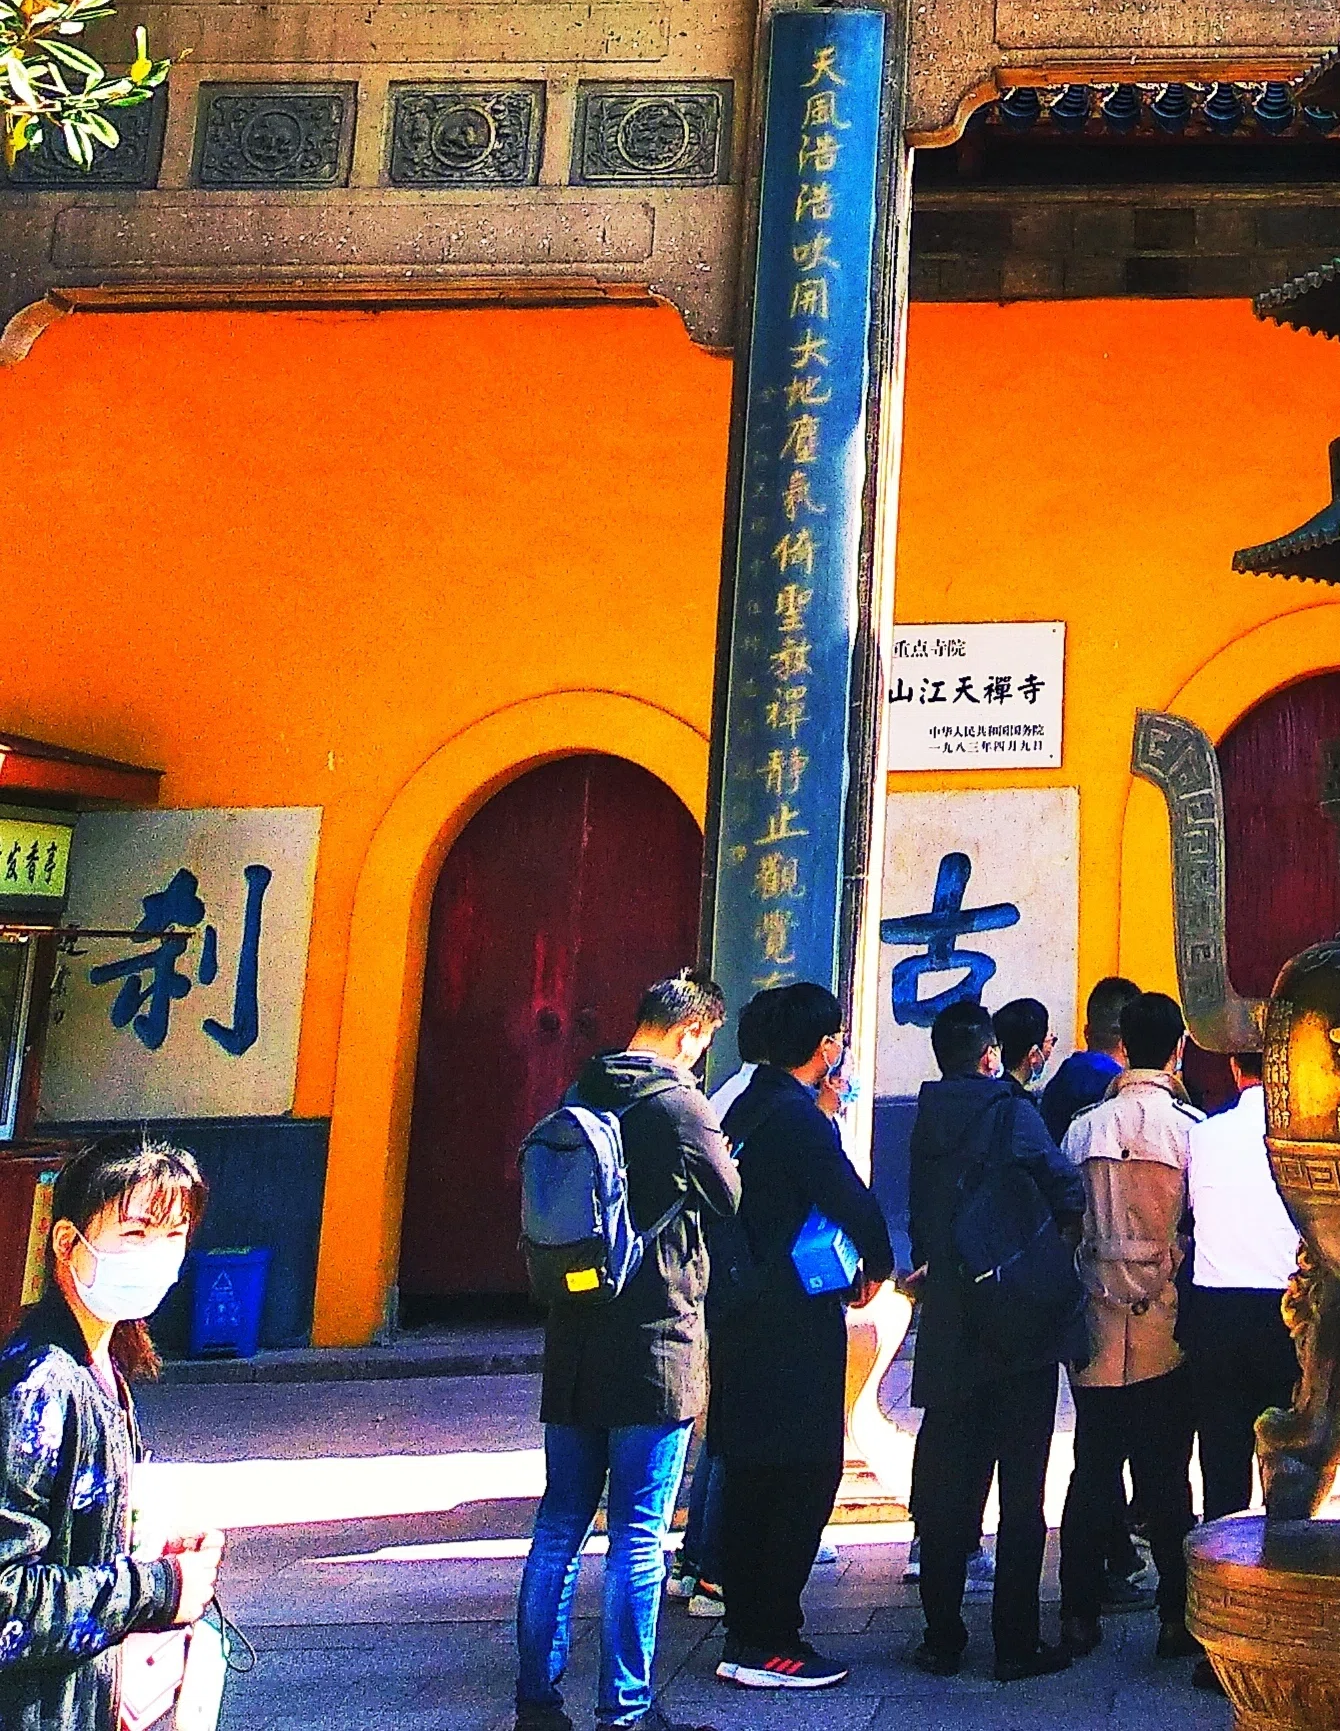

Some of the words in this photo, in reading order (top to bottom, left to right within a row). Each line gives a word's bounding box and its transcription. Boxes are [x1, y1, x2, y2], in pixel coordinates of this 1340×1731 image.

[889, 674, 1046, 705] 山江天禪寺
[929, 724, 1045, 739] 中华人民共和国国务院
[928, 739, 1043, 754] 一九八三年四月九日
[880, 852, 1021, 1028] 古
